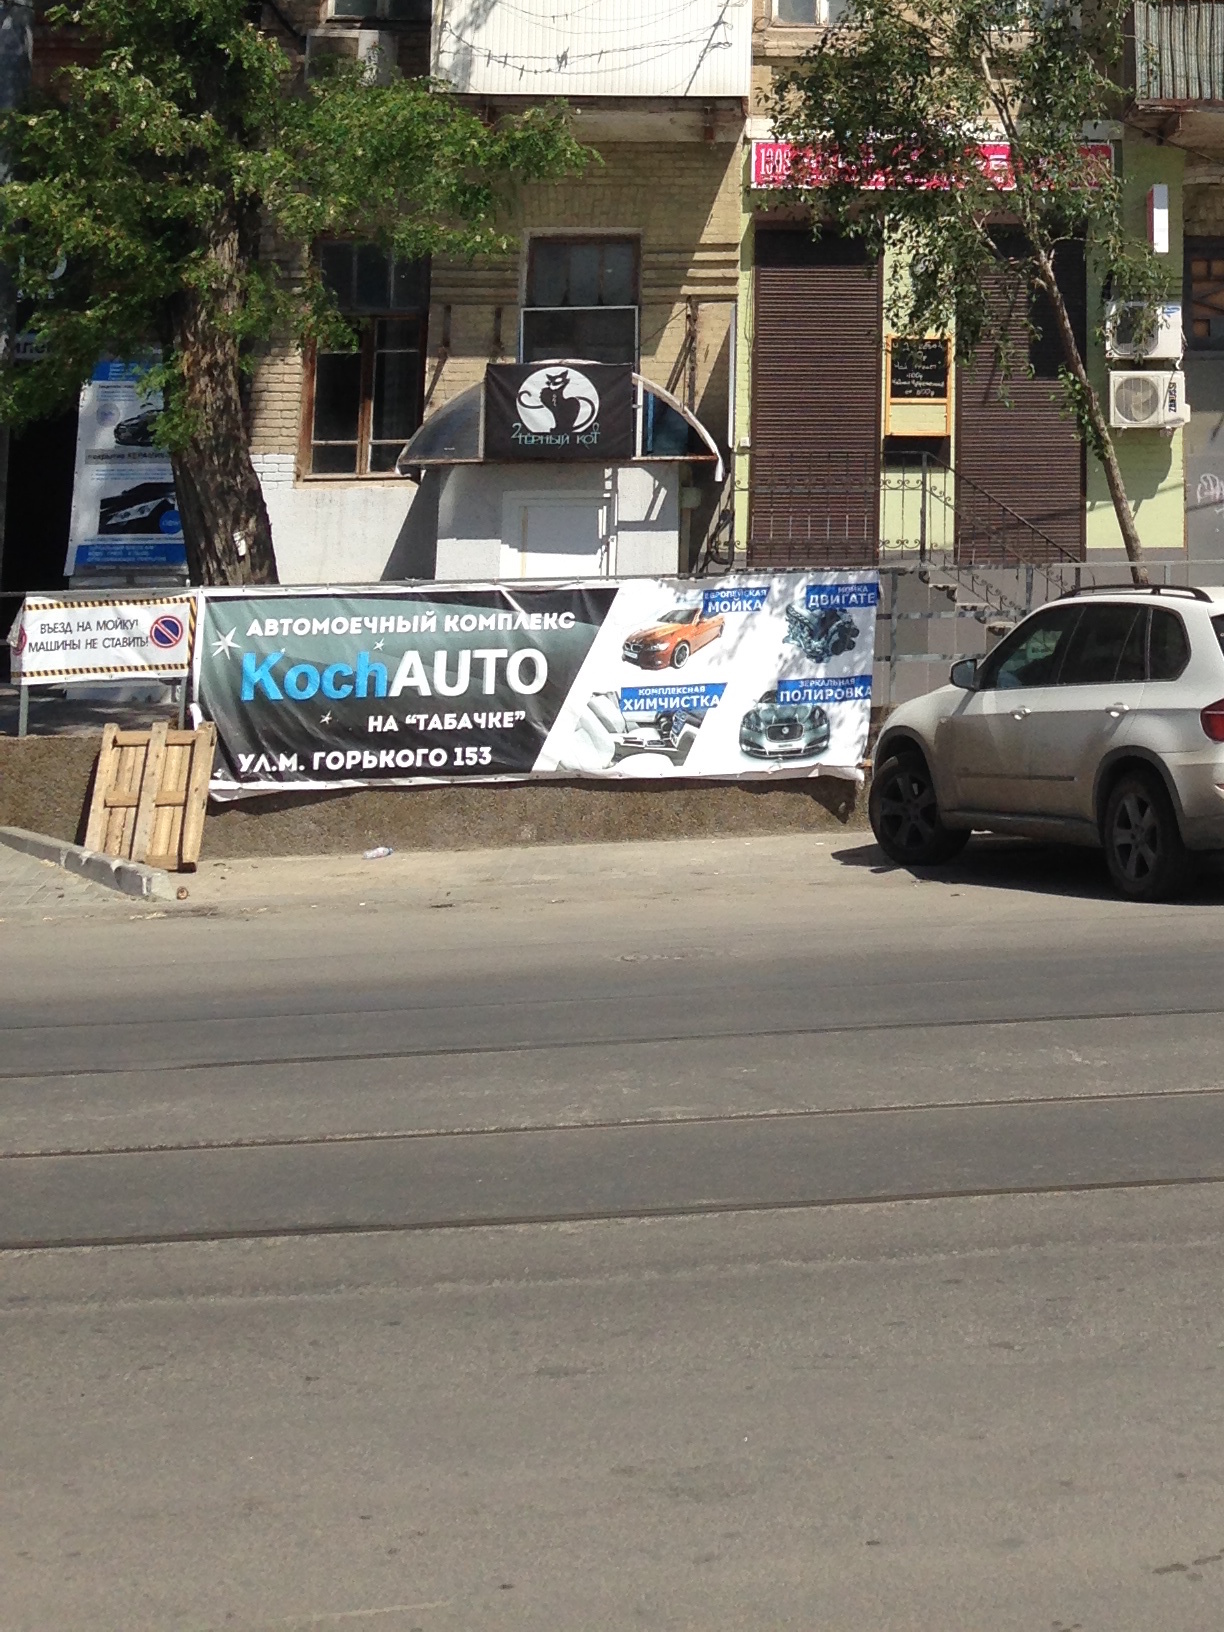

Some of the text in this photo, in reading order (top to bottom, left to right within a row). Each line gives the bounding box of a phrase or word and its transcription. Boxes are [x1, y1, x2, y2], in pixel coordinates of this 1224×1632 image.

[837, 585, 869, 594] МОЙКА
[708, 597, 764, 613] МОЙКА
[40, 617, 139, 635] ВЪЕЗД НА МОЙКУ!
[246, 611, 576, 637] АВТОМОЕЧНЫЙ КОМПЛЕКС
[28, 636, 149, 653] МАШИНЫ НЕ СТАВИТЬ!
[241, 648, 549, 701] KochAUTO
[799, 677, 856, 688] ЗЕРКАЛЬНАЯ
[638, 685, 706, 696] КОМПЛЕКСНАЯ
[779, 685, 872, 703] ПОЛИРОВКА
[623, 694, 720, 711] ХИМЧИСТКА
[368, 715, 399, 733] НА
[312, 748, 448, 770] ГОРЬКОГО
[453, 746, 492, 766] 153
